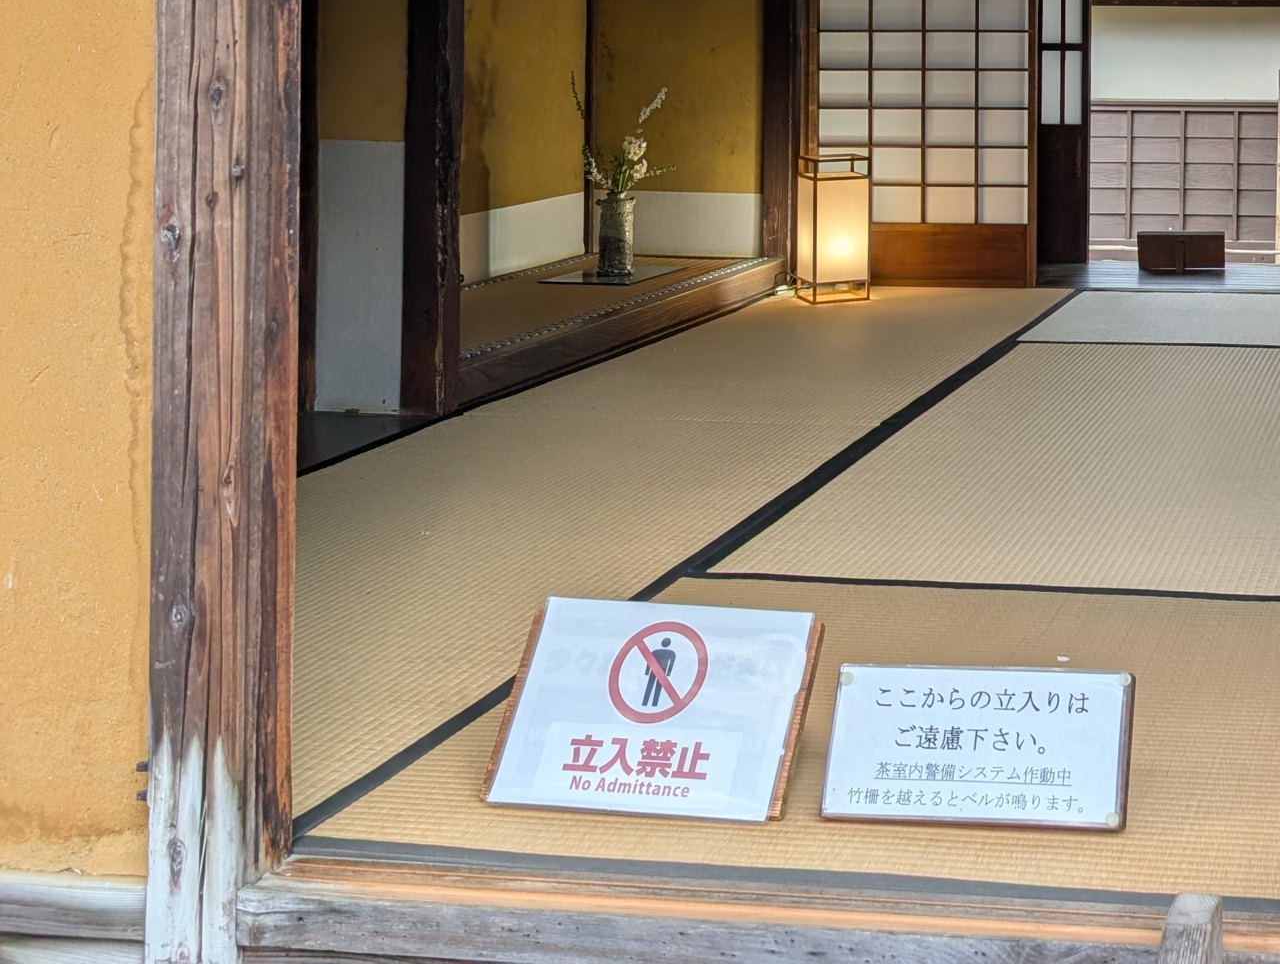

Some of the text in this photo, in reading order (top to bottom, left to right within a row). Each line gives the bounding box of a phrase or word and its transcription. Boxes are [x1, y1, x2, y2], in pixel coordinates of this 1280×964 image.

[875, 687, 1090, 714] ここからの立入りは
[894, 725, 1047, 755] ご遠慮下さい。
[562, 735, 711, 780] 立入禁止
[875, 762, 1072, 784] 茶室内警備システム作動中
[569, 776, 690, 798] No Admittance
